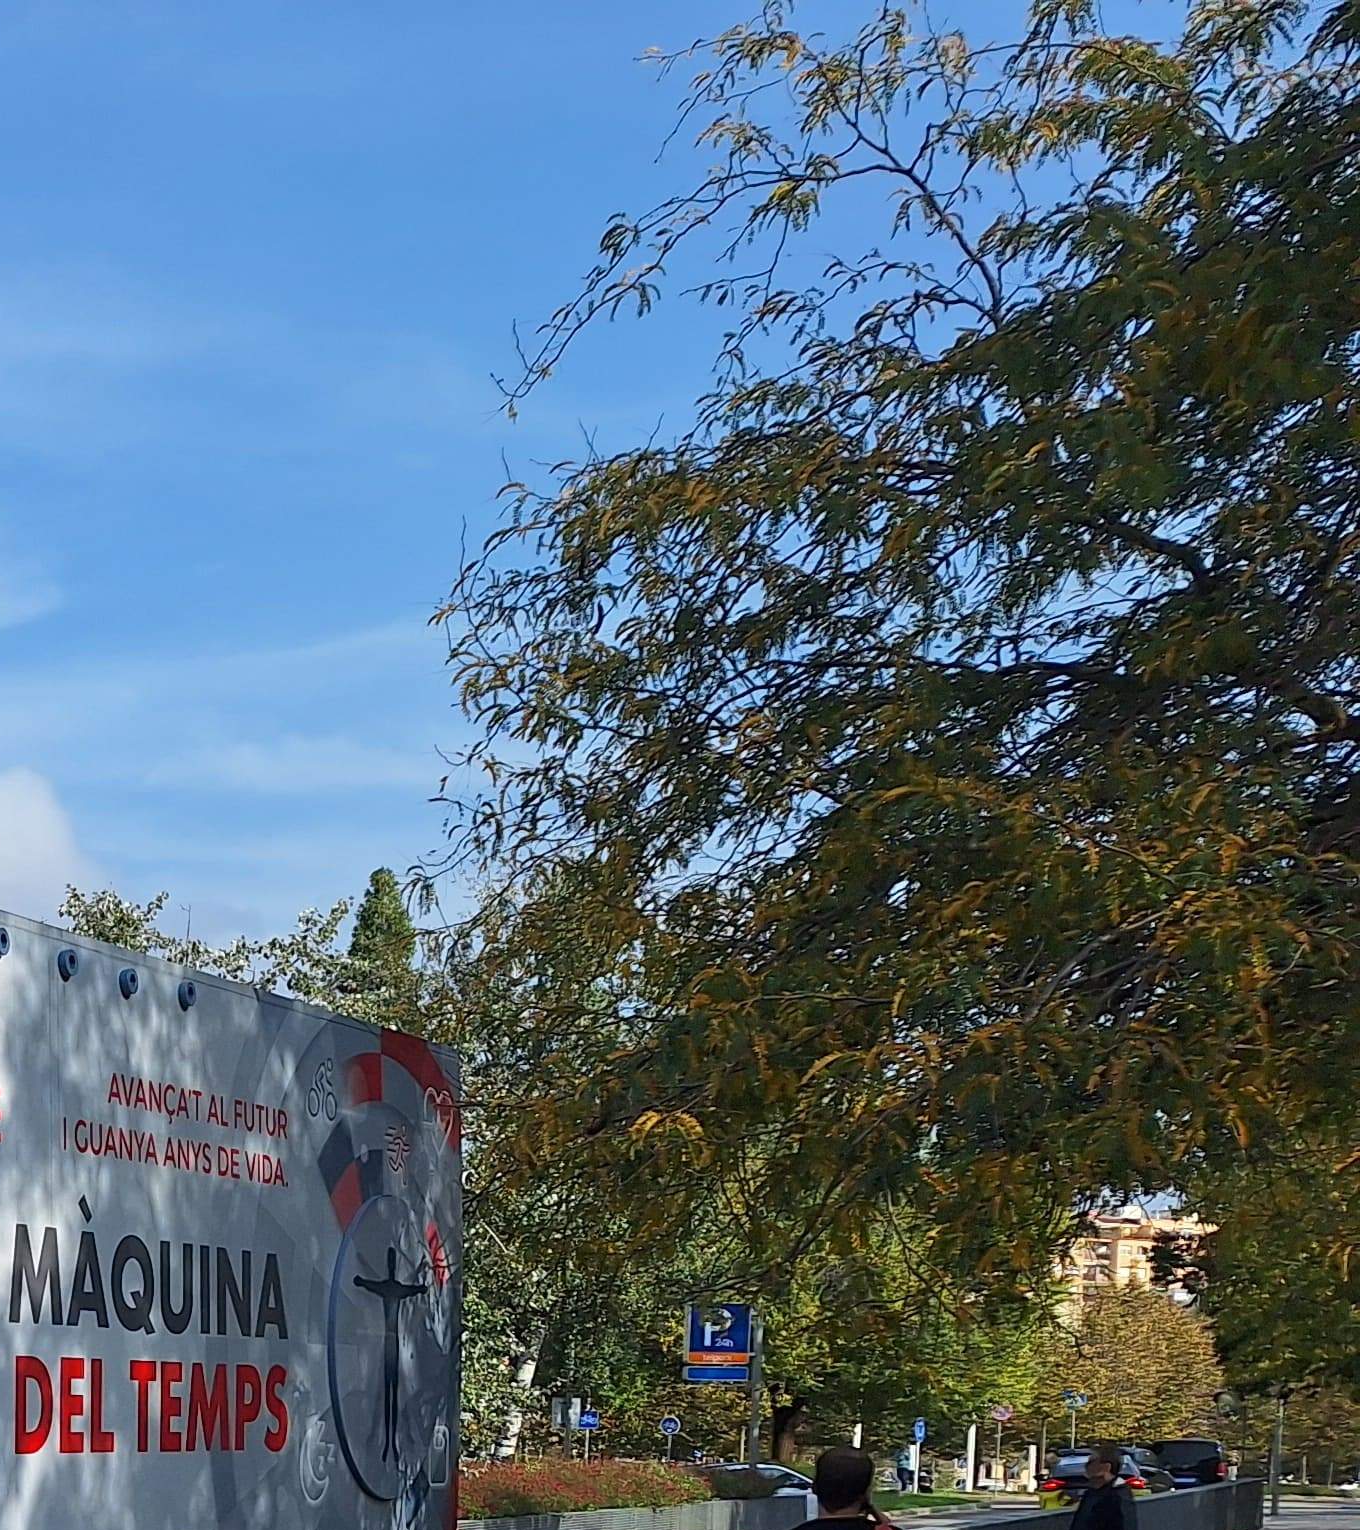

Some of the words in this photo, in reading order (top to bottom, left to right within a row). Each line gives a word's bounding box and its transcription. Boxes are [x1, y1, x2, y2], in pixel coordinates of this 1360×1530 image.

[107, 1072, 202, 1124] AVANÇA'T
[206, 1094, 230, 1127] AL
[233, 1098, 289, 1140] FUTUR
[74, 1119, 159, 1166] GUANYA
[163, 1136, 212, 1175] ANYS
[217, 1145, 241, 1180] DE
[245, 1150, 289, 1188] VIDA.
[8, 1194, 290, 1341] MÀQUINA
[14, 1355, 115, 1455] DEL
[129, 1359, 290, 1453] TEMPS
